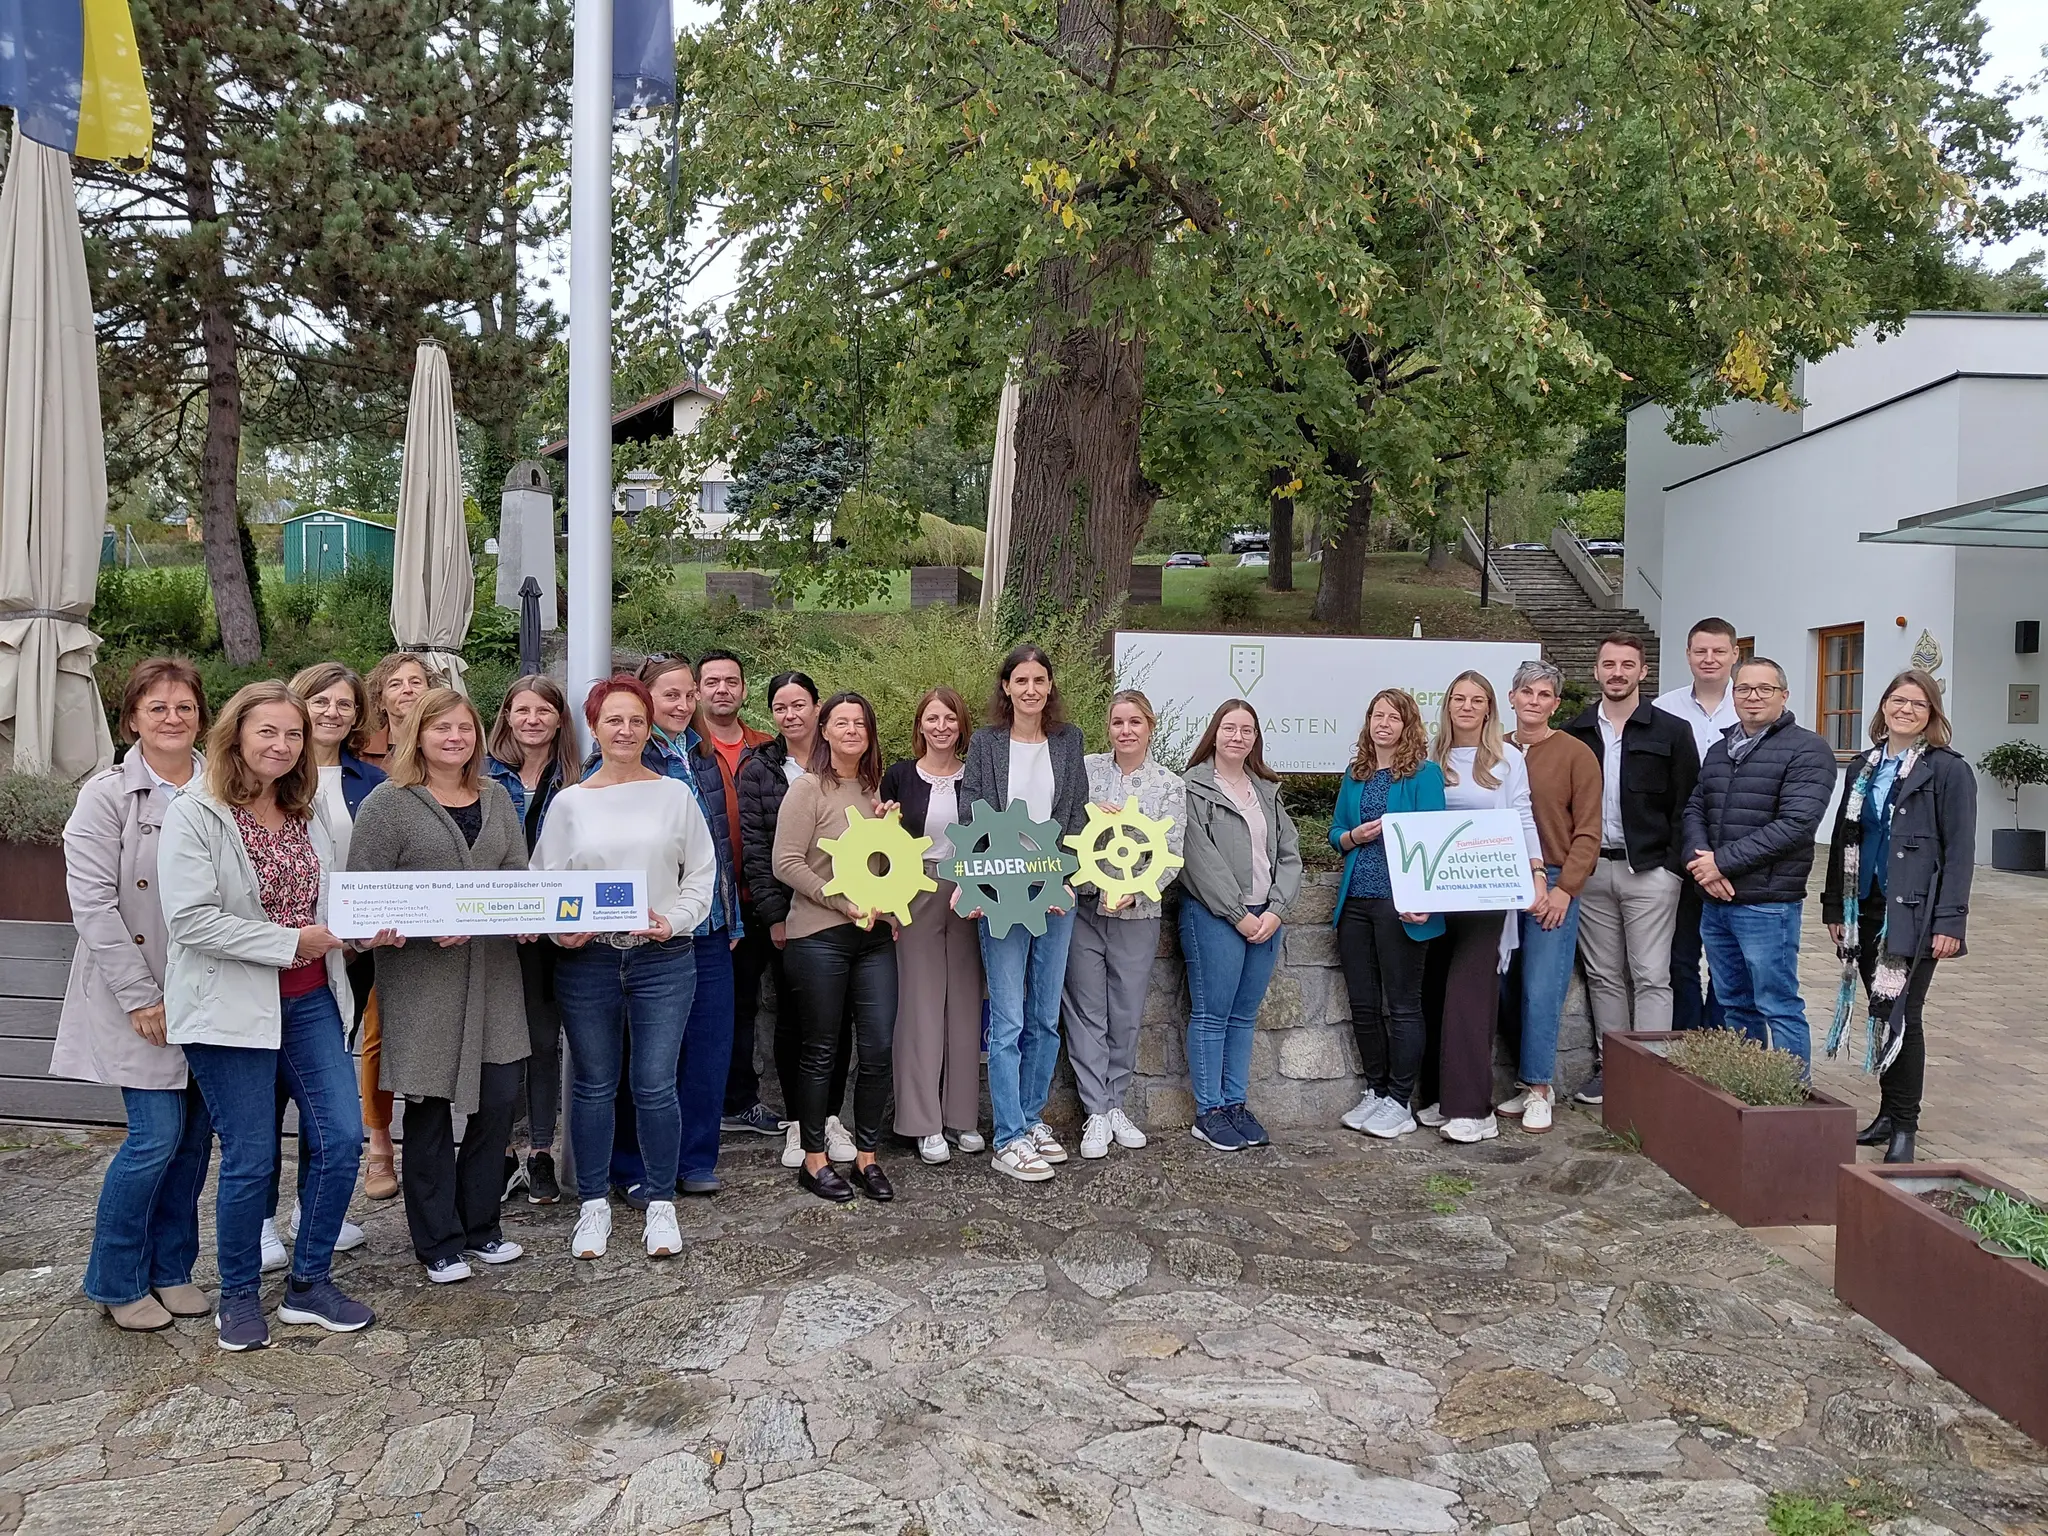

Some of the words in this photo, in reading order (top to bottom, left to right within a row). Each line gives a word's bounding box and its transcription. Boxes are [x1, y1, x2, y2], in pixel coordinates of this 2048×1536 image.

[954, 855, 1063, 877] #LEADERwirkt
[357, 882, 413, 891] Unterstützung
[432, 882, 453, 890] Bund,
[492, 881, 539, 890] Europäischer
[1436, 883, 1488, 891] NATIONALPARK
[1488, 881, 1522, 889] THAYATAL
[456, 902, 485, 913] WIR
[488, 901, 515, 911] leben
[517, 901, 541, 910] Land
